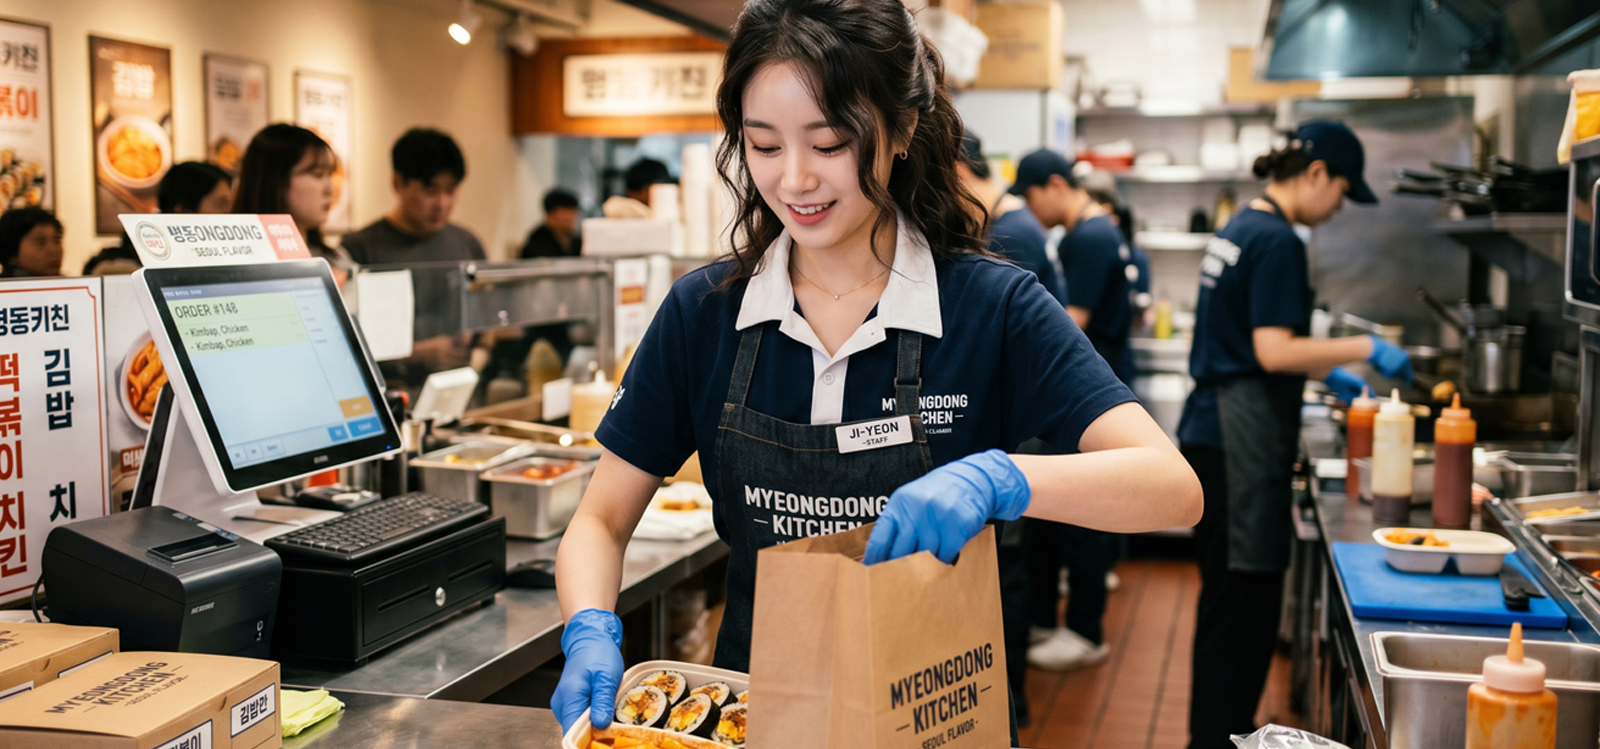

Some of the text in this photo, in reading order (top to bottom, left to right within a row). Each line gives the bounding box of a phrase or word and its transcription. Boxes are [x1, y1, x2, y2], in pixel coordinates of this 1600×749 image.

[224, 246, 253, 256] FLAVOR
[175, 302, 238, 318] ORDER #148
[220, 324, 249, 334] Chicken
[226, 337, 255, 348] Chicken
[44, 348, 74, 431] 김밥
[850, 422, 899, 439] JI-YEON
[744, 485, 889, 517] MYEONGDONG
[44, 661, 168, 713] MYEONGDONG
[92, 672, 175, 705] KITCHEN
[891, 642, 993, 710] MYEONGDONG
[913, 681, 978, 735] KITCHEN
[922, 718, 975, 749] SEOUL FLAVOR
